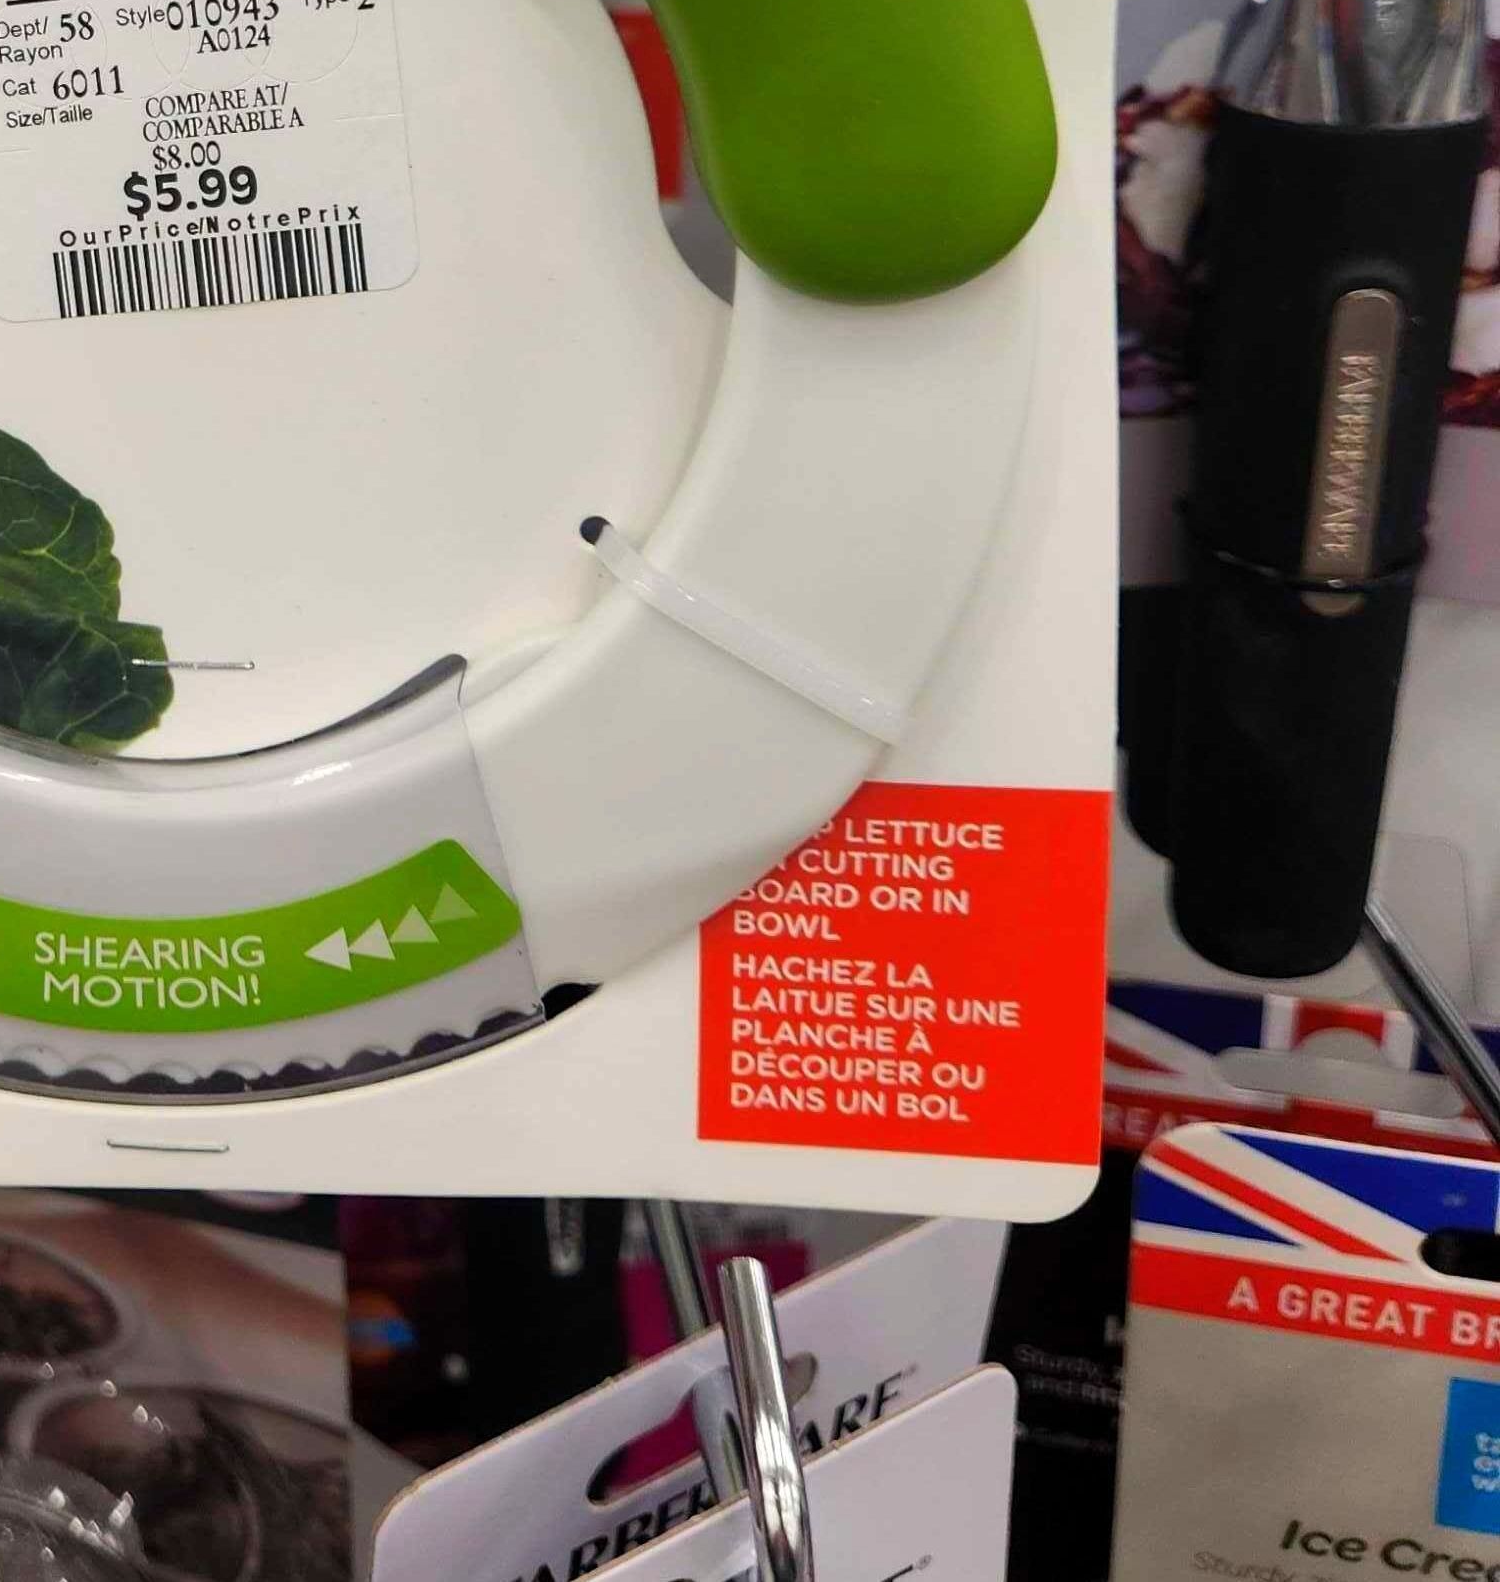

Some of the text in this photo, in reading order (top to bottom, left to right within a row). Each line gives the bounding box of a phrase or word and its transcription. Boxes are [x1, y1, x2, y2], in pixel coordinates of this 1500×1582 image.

[60, 11, 94, 42] 58
[116, 5, 165, 29] Style
[197, 24, 270, 53] A0124
[2, 65, 124, 100] Cat 6011
[145, 82, 288, 118] COMPARE AT/
[6, 103, 93, 128] Size/Taille
[143, 106, 305, 142] COMPARABLE A
[153, 140, 221, 171] $8.00
[124, 165, 257, 221] $5.99
[845, 818, 1004, 850] LETTUCE
[799, 849, 954, 880] CUTTING
[870, 886, 920, 913] OR
[933, 888, 969, 915] IN
[734, 910, 840, 940] BOWL
[34, 932, 265, 971] SHEARING
[733, 954, 933, 989] HACHEZ LA
[43, 974, 262, 1008] MOTION!
[733, 986, 1020, 1027] LAITUE SUR UNE
[732, 1018, 933, 1055] PLANCHE À
[731, 1048, 986, 1090] DÉCOUPER OU
[731, 1083, 970, 1122] DANS UN BOL
[1228, 1276, 1259, 1312] A
[1277, 1283, 1435, 1339] GREAT
[1280, 1520, 1368, 1562] Ice
